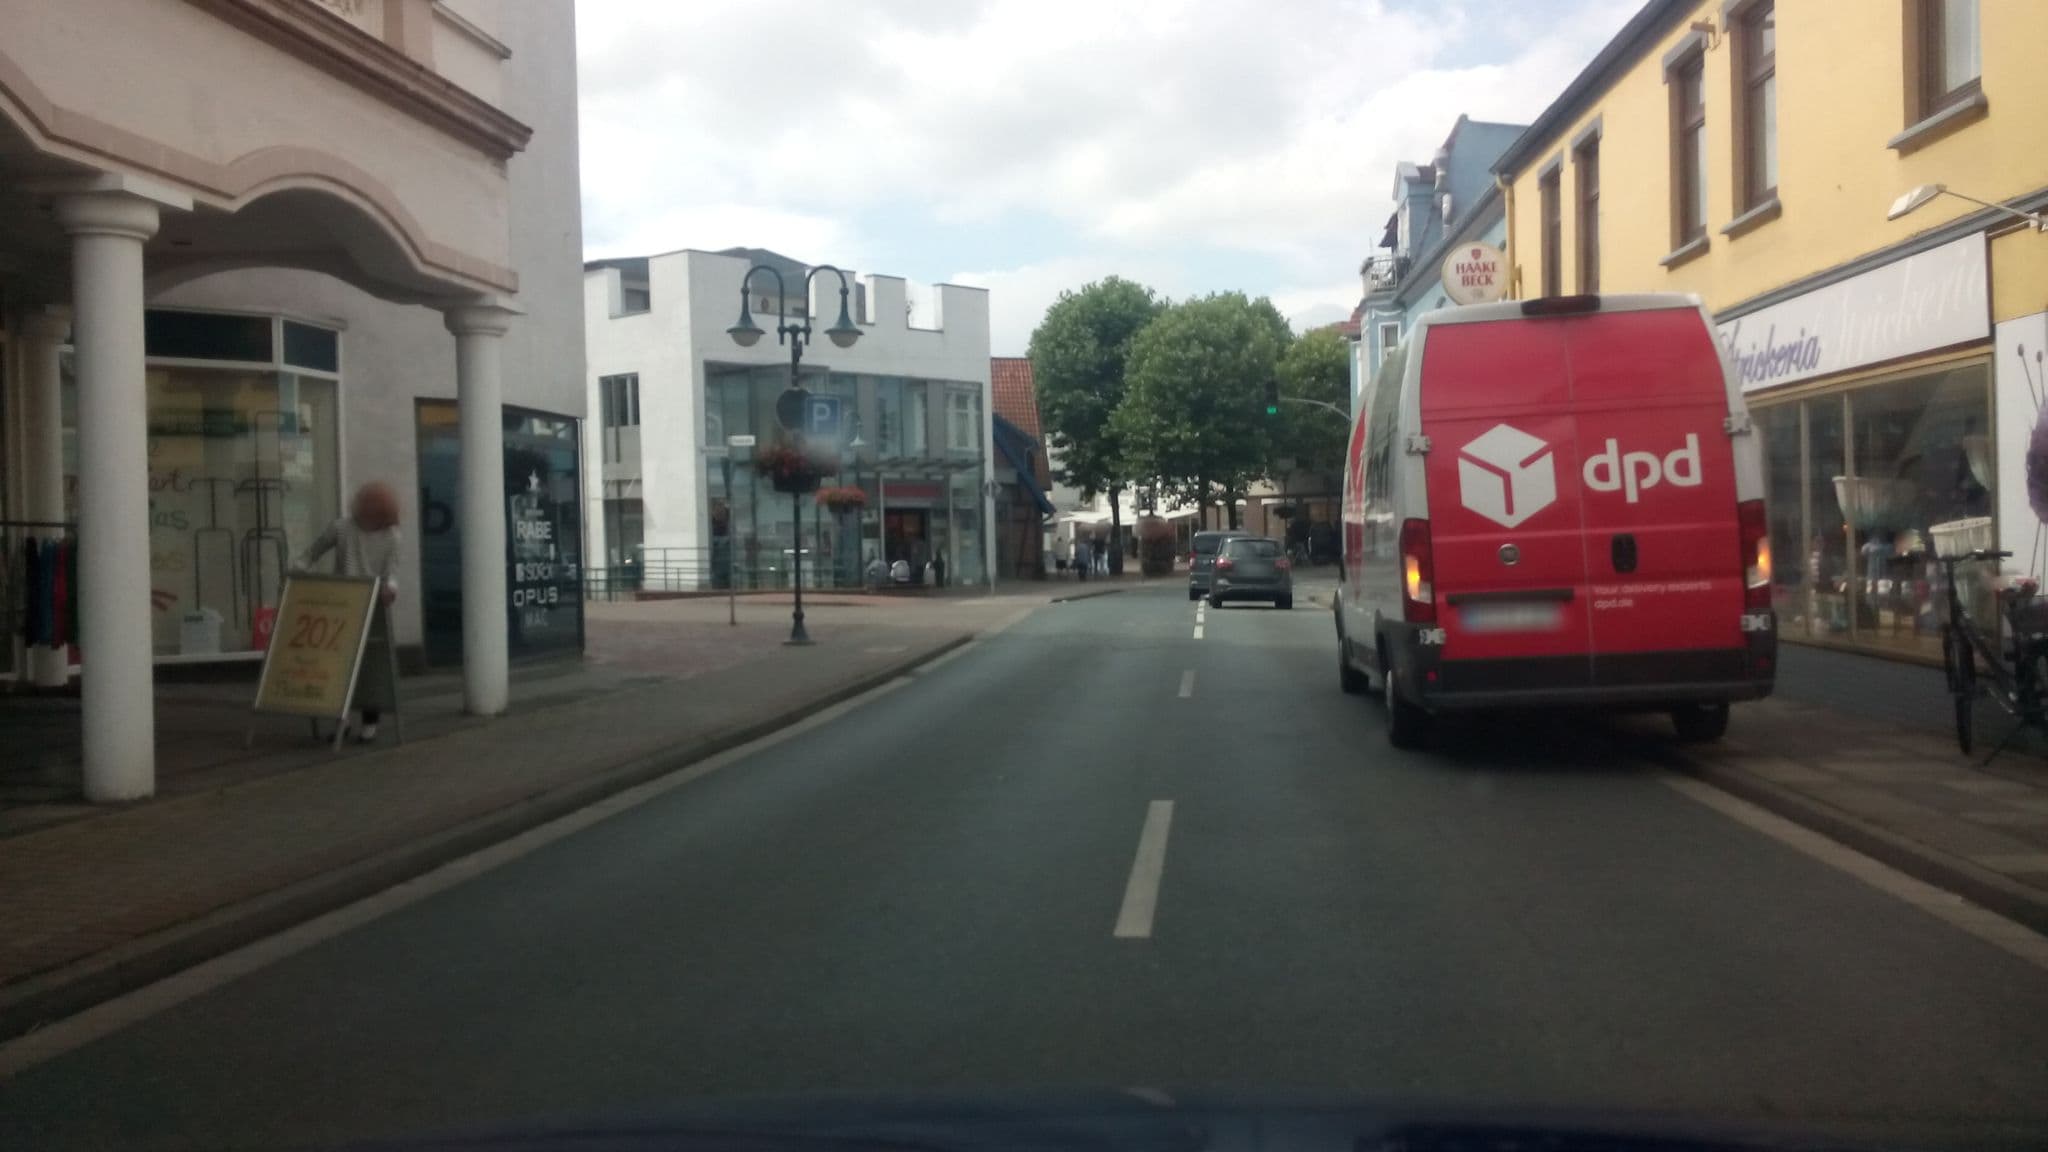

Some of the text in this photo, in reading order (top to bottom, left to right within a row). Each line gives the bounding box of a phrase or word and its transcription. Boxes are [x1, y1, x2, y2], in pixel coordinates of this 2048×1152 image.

[1456, 262, 1497, 274] HAAKE
[1462, 274, 1494, 287] BECK
[812, 403, 831, 432] P
[1583, 433, 1702, 503] dpd
[516, 521, 552, 539] RABE
[513, 587, 558, 607] OPUS
[1593, 581, 1712, 596] Your delivery experts
[1594, 598, 1633, 610] dpd.de
[288, 613, 346, 651] 20%
